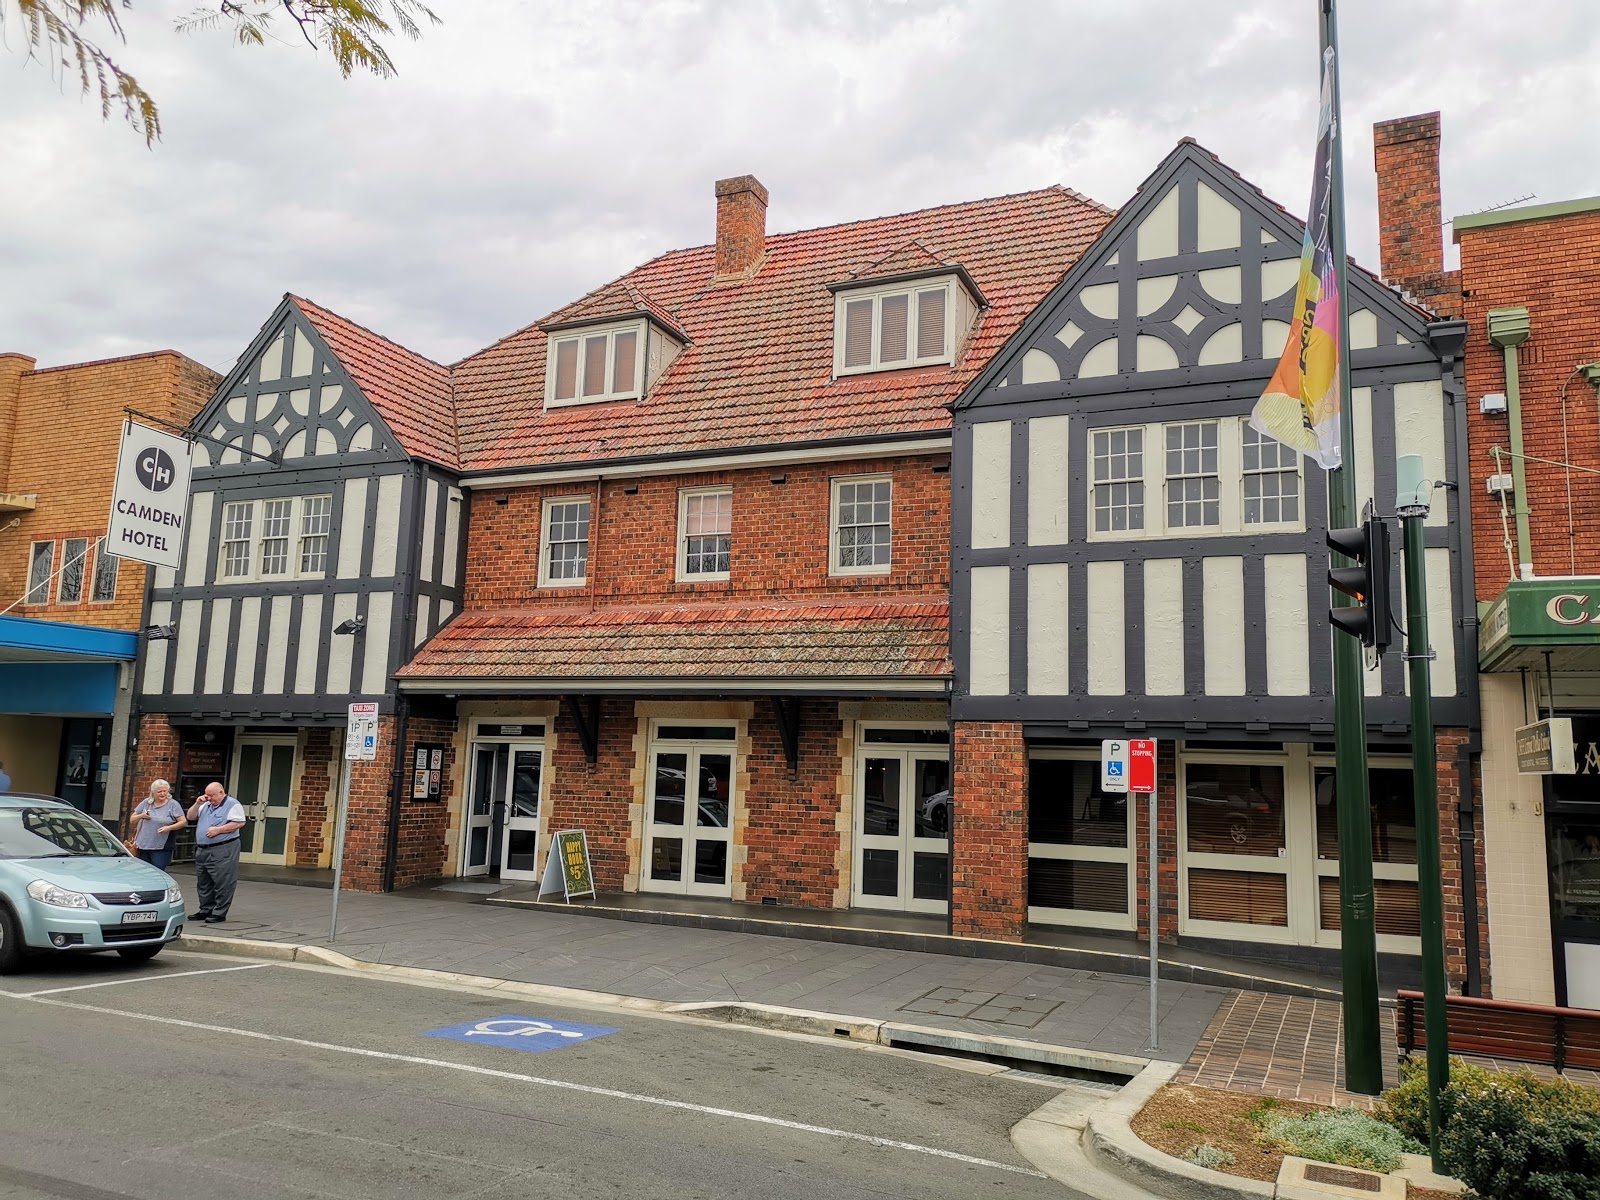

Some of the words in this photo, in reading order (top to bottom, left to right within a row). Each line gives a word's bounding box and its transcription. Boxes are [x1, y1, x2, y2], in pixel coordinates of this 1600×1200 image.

[117, 499, 182, 529] CAMDEN
[121, 527, 169, 552] HOTEL
[1545, 594, 1600, 627] C
[353, 704, 363, 712] TAXI
[351, 722, 361, 733] 1P
[367, 722, 374, 732] P
[1110, 743, 1121, 756] P
[565, 840, 582, 853] HAPPY
[567, 853, 584, 866] HOUR
[569, 865, 582, 880] $5
